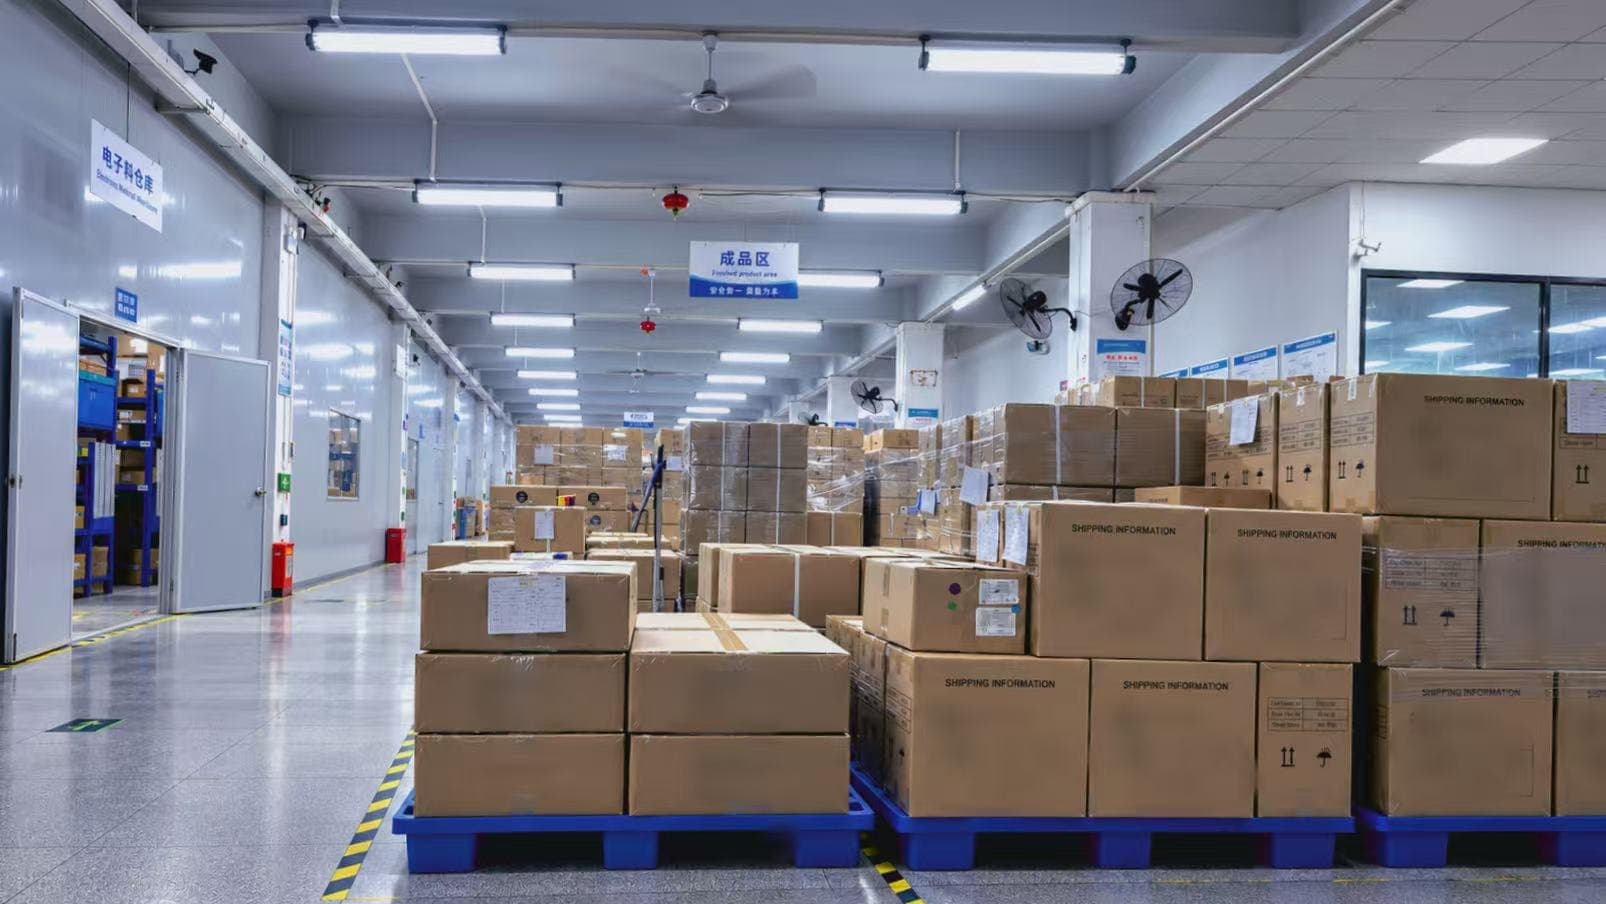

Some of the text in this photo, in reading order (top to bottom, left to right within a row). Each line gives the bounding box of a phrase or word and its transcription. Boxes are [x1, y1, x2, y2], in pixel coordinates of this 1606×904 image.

[103, 146, 153, 195] 电子料仓库
[720, 251, 770, 267] 成品区
[1424, 395, 1524, 406] SHIPPING INFORMATION
[1072, 524, 1176, 535] SHIPPING INFORMATION
[1237, 529, 1337, 540] SHIPPING INFORMATION
[1518, 540, 1558, 548] SHIPPING
[944, 679, 1056, 688] SHIPPING INFORMATION
[1123, 681, 1229, 690] SHIPPING INFORMATION
[1421, 688, 1521, 697] SHIPPING INFORMATION
